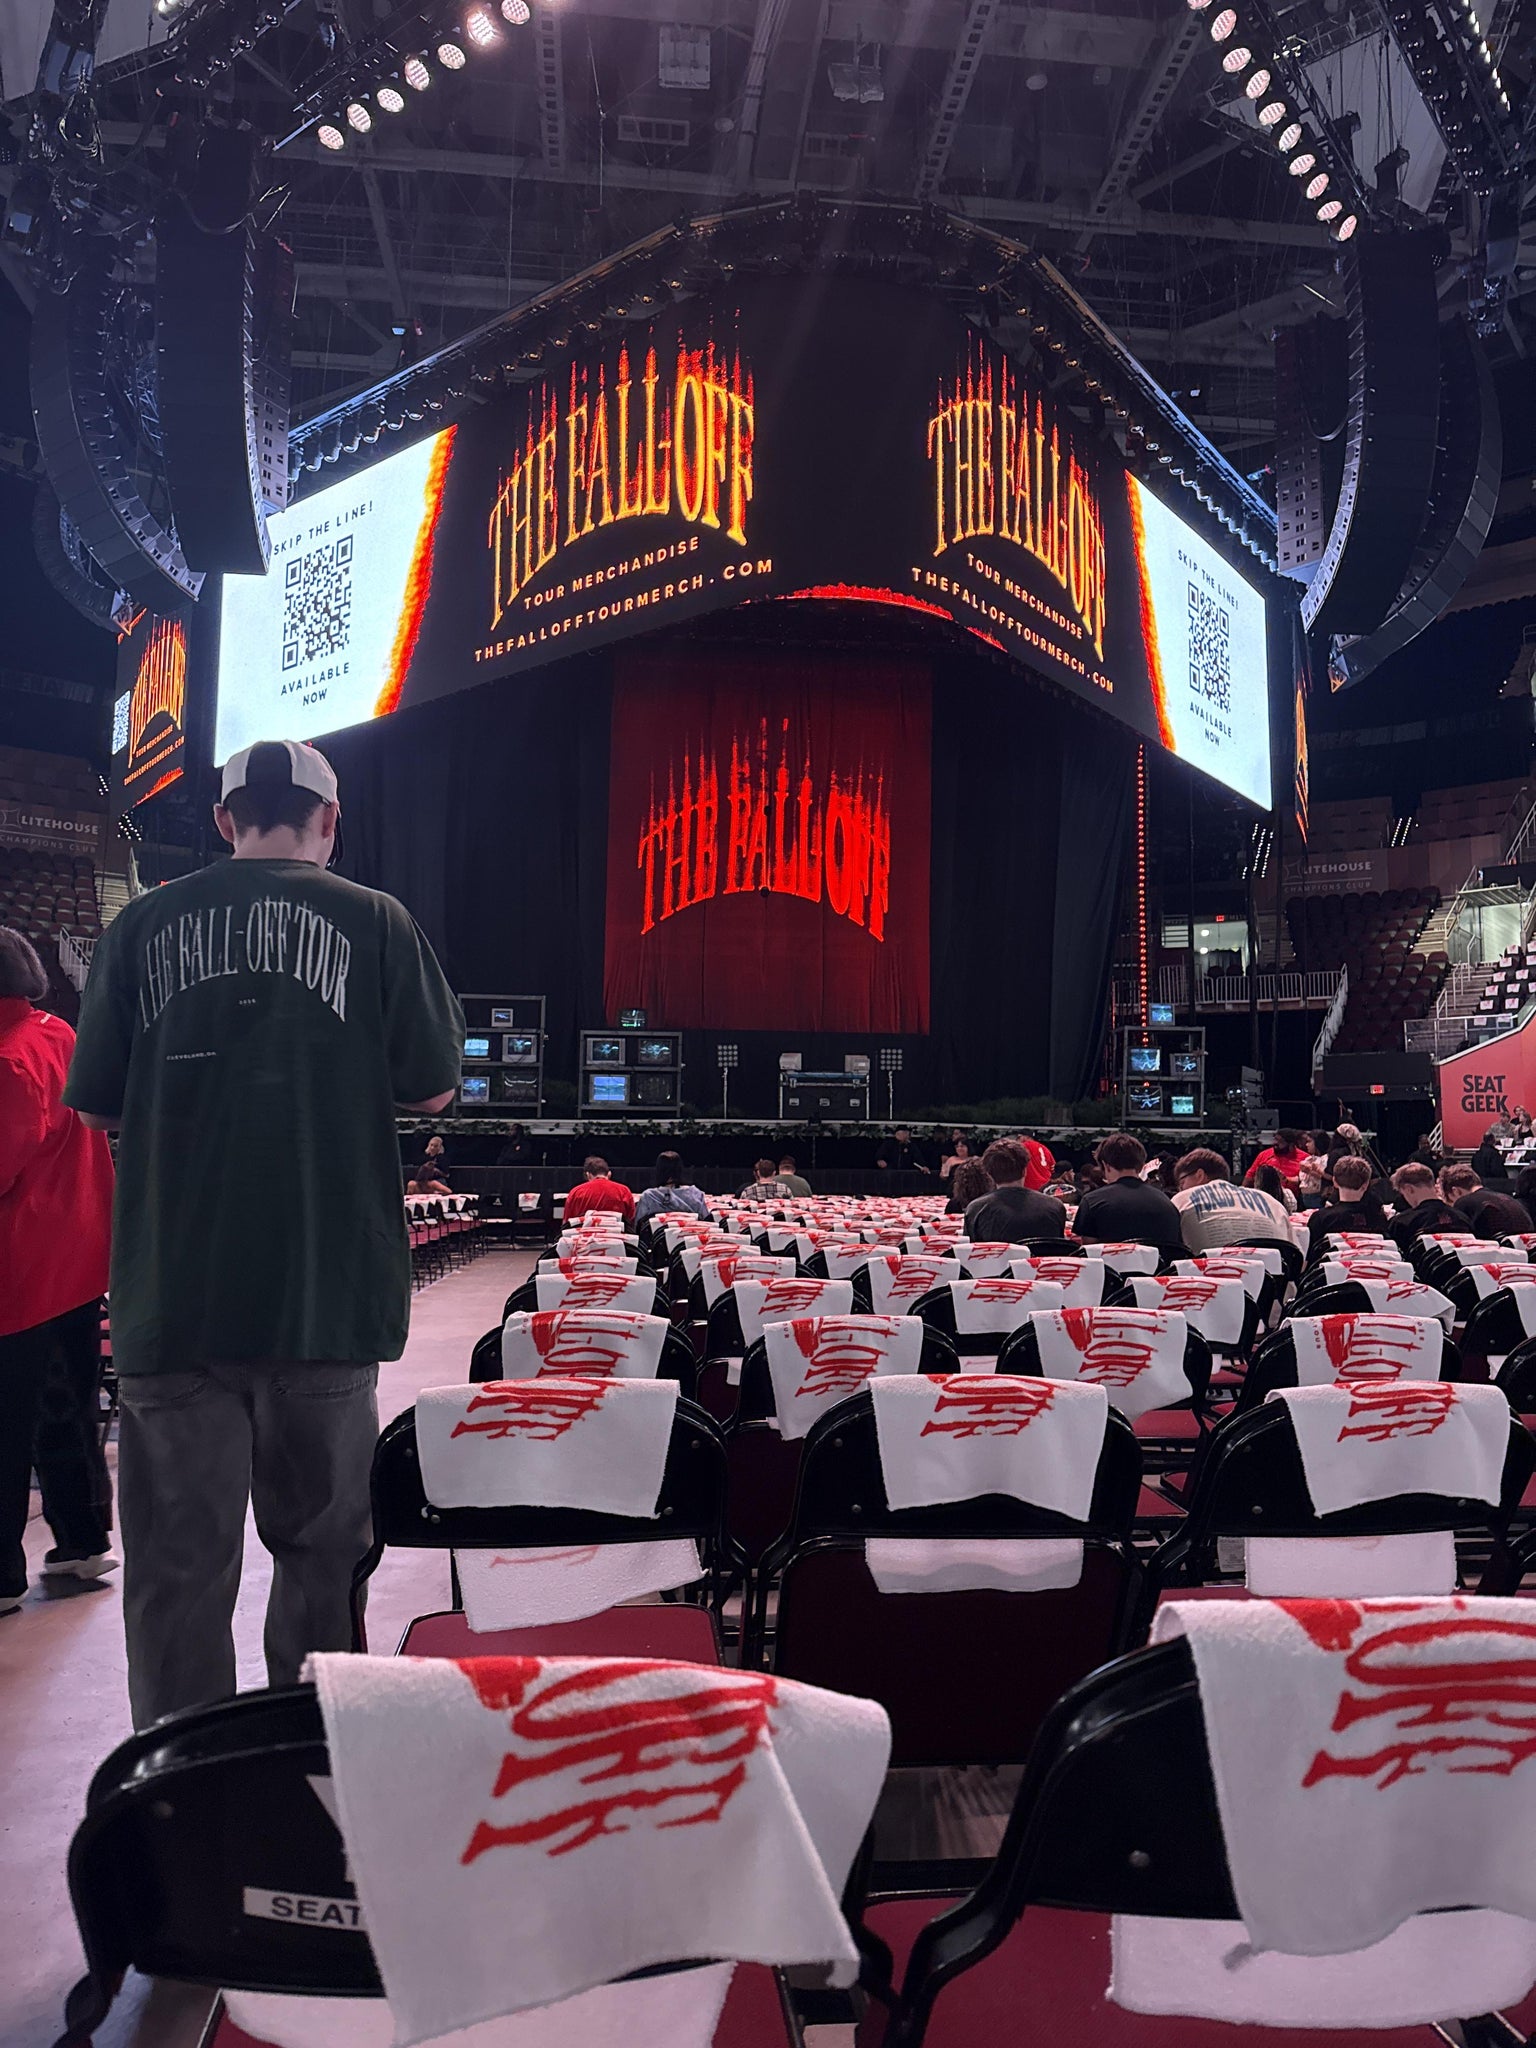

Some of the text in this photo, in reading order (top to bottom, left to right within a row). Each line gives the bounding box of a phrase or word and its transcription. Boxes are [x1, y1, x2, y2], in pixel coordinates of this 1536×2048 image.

[928, 375, 995, 557] THE
[273, 500, 374, 556] SKIP THE LINE!
[489, 405, 557, 630] THE
[524, 536, 700, 610] TOUR MERCHANDISE
[1177, 549, 1239, 611] SKIP THE LINE!
[967, 552, 1082, 639] TOUR MERCHANDISE
[281, 662, 350, 696] AVAILABLE
[303, 688, 328, 706] NOW
[1189, 701, 1232, 738] AVAILABLE
[1204, 728, 1220, 747] NOW
[21, 815, 99, 835] LITEHOUSE
[0, 835, 96, 853] CHAMPIONS CLUB
[637, 765, 718, 935] THE
[1303, 861, 1372, 875] LITEHOUSE
[1284, 881, 1371, 893] CHAMPIONS CLUB
[179, 896, 291, 992] FALL-OFF
[294, 900, 351, 1022] TOUR
[1462, 1074, 1506, 1093] SEAT
[1461, 1094, 1509, 1113] GEEK
[271, 1896, 361, 1926] SEAT
